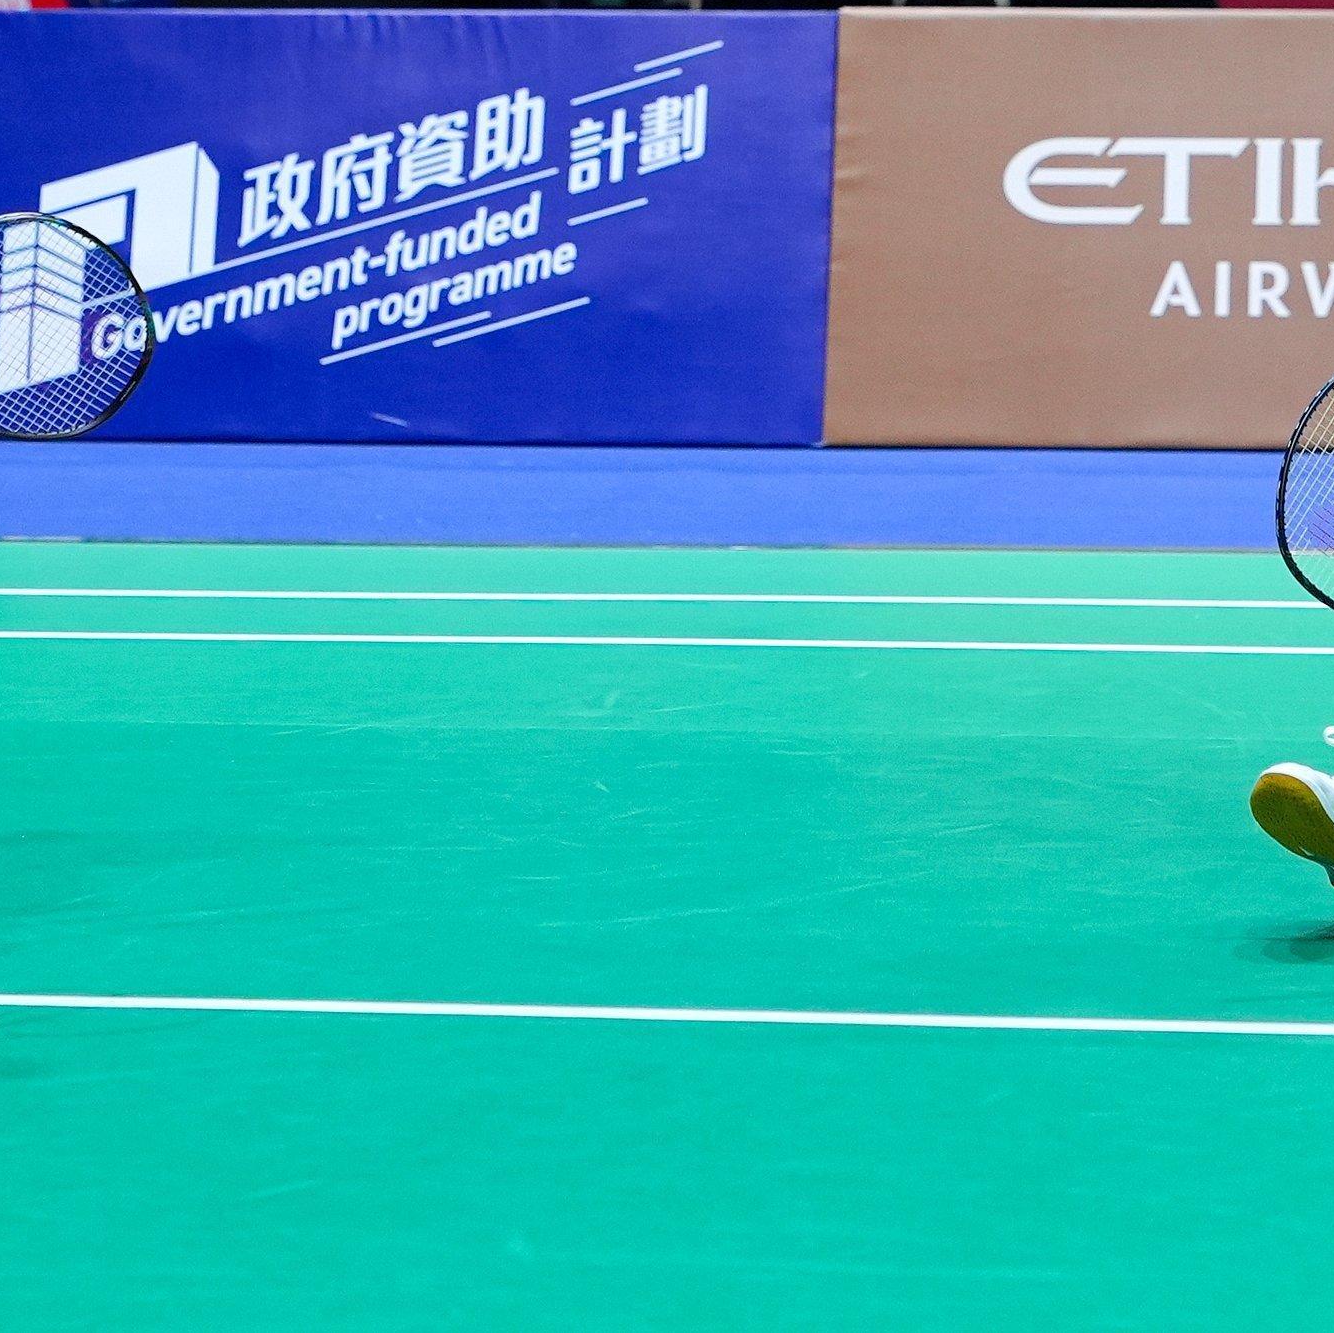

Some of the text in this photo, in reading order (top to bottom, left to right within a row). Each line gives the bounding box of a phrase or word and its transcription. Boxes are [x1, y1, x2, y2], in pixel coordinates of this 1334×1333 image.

[236, 83, 709, 248] 政府資助 計劃
[89, 191, 542, 361] Government-funded
[331, 241, 578, 351] programme
